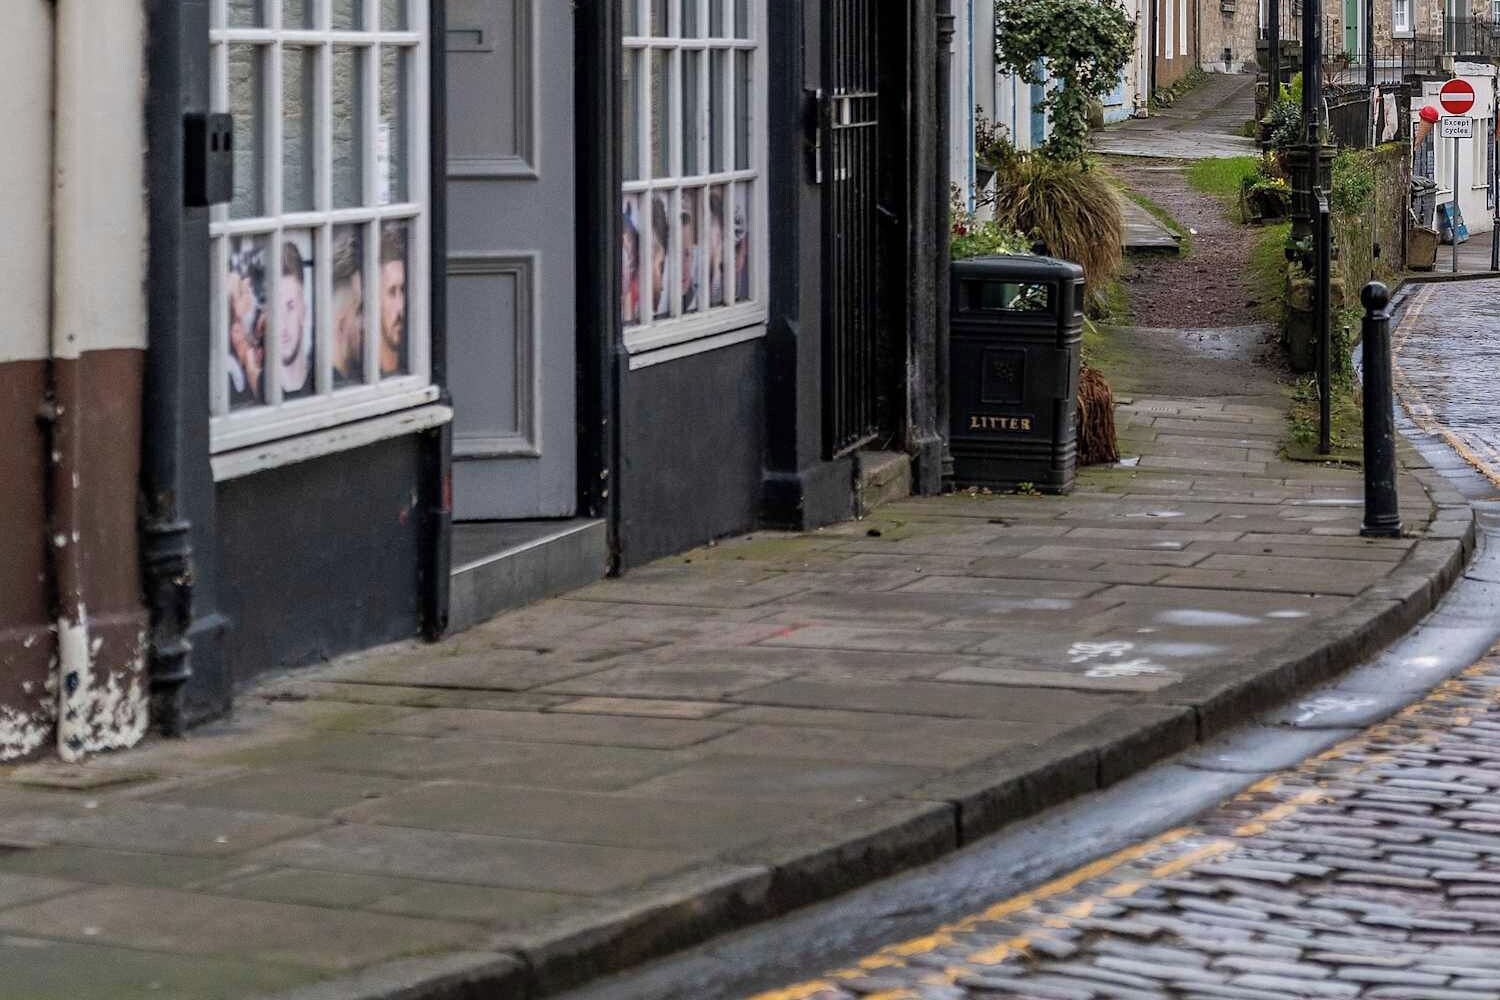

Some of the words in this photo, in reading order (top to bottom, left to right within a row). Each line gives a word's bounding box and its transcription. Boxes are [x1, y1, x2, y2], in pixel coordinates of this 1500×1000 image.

[1444, 119, 1469, 127] Except
[1445, 127, 1468, 135] cycles
[969, 415, 1032, 430] LITTER
